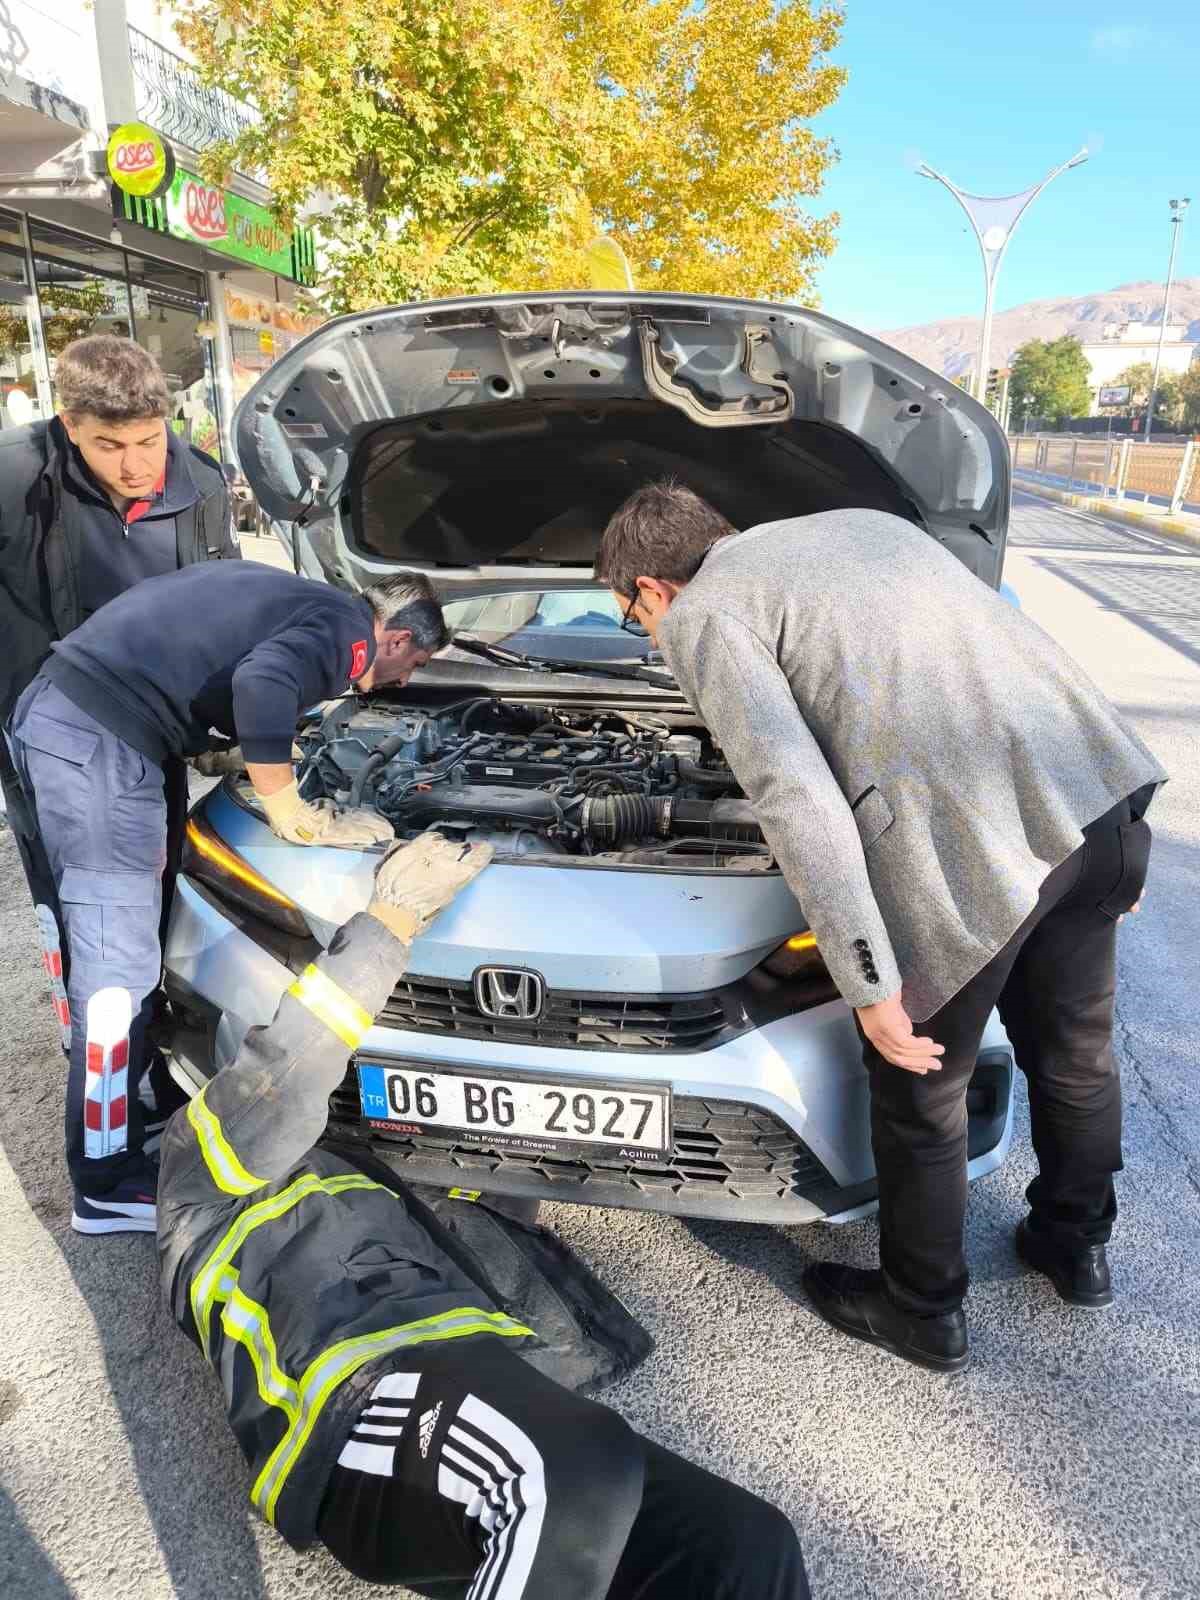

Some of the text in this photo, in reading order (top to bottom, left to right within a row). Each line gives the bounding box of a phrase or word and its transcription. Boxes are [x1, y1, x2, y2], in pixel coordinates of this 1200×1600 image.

[366, 1094, 385, 1107] TR
[387, 1074, 654, 1141] 06 BG 2927
[368, 1120, 424, 1135] HONDA
[463, 1133, 480, 1143] The
[481, 1135, 509, 1146] Power
[421, 1400, 443, 1459] adidas
